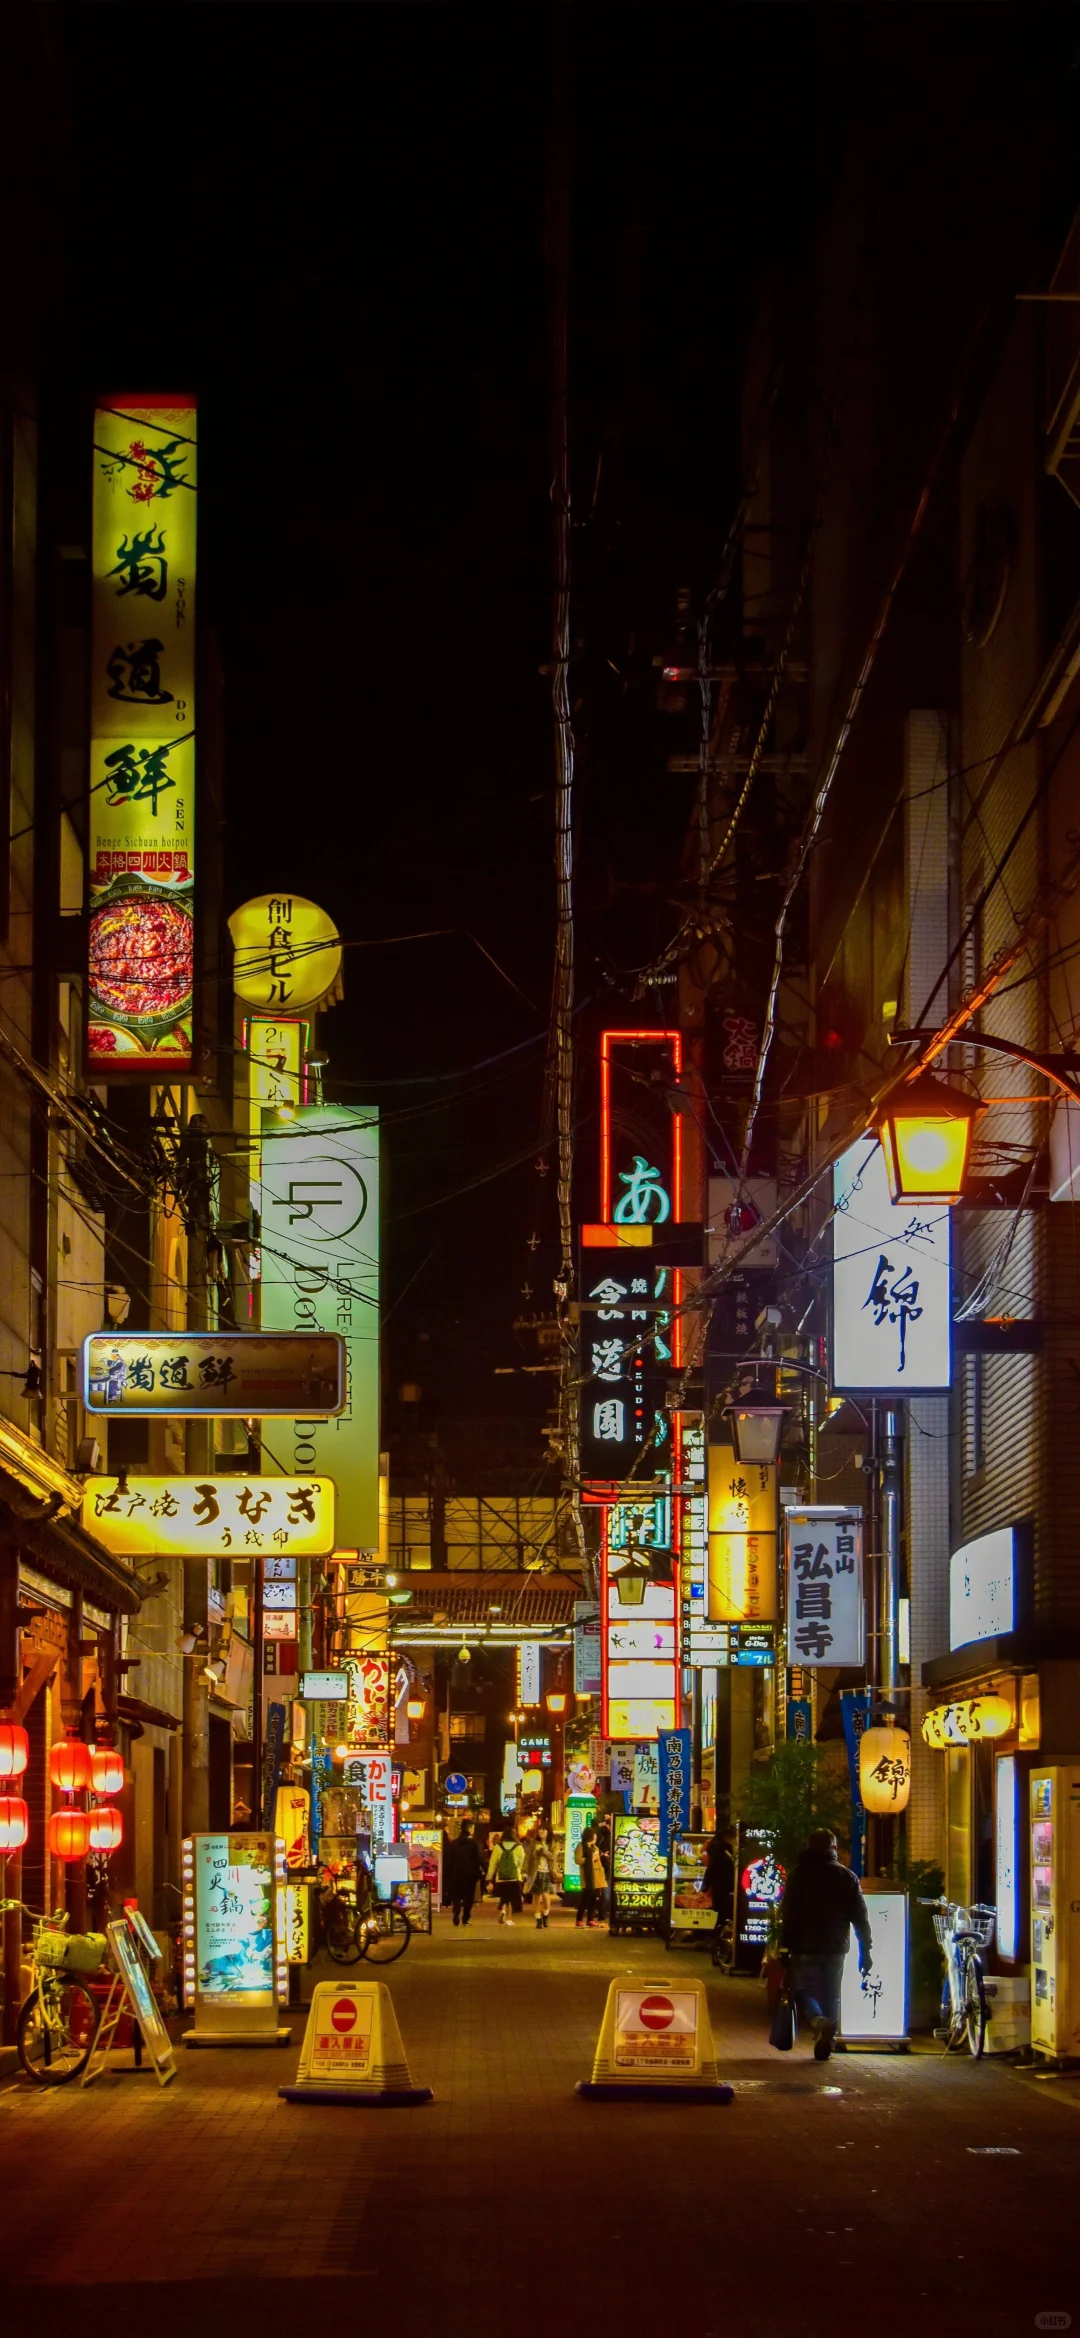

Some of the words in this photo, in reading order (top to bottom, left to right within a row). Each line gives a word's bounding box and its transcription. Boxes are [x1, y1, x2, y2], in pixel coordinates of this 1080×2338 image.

[176, 700, 186, 722] DO
[176, 798, 186, 832] SEN
[97, 852, 188, 872] 本格四川火鍋
[125, 835, 159, 847] Sichuan
[162, 835, 189, 848] hotpot
[267, 898, 294, 1004] 創食ビル
[861, 1254, 923, 1372] 錦
[192, 1483, 322, 1527] うなぎ
[794, 1542, 834, 1659] 弘昌寺
[520, 1738, 550, 1746] GAME
[368, 1760, 387, 1801] かに
[666, 1738, 684, 1840] 南乃福寿弁才
[869, 1755, 905, 1801] 錦
